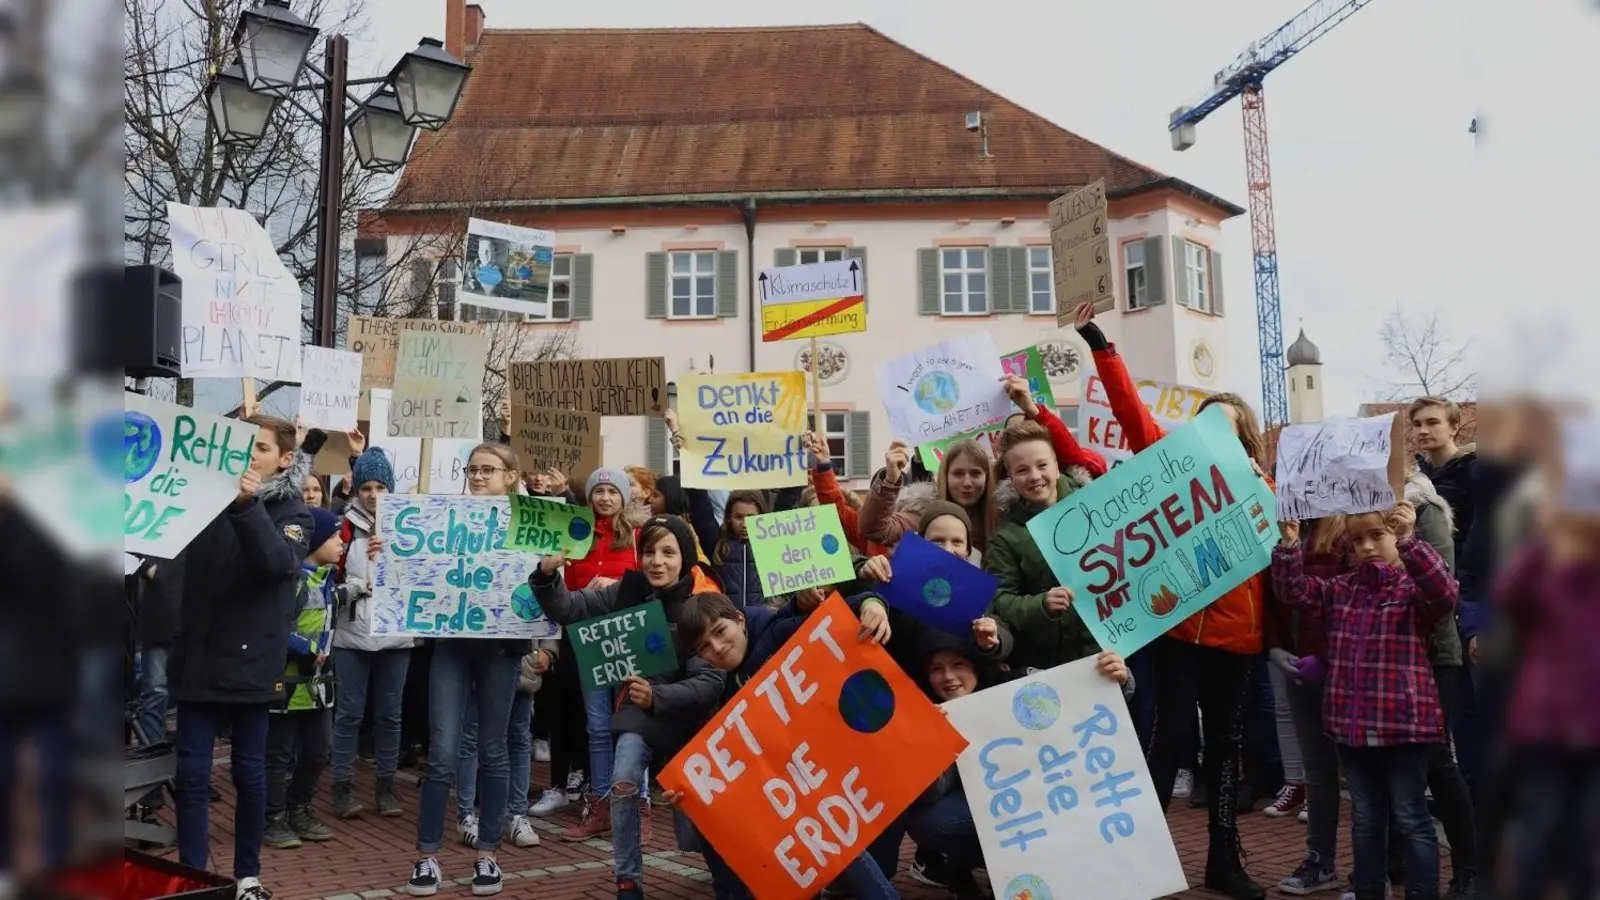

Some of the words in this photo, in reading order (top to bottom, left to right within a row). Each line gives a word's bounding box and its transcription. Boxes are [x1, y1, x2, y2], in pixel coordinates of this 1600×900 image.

[1093, 216, 1101, 236] 6
[190, 239, 282, 279] GIRL
[1094, 246, 1103, 264] 6
[215, 278, 274, 302] NT
[769, 272, 849, 296] Klimaschutz
[1097, 275, 1105, 293] 6
[357, 317, 398, 335] THERE
[183, 325, 290, 377] PLANET
[353, 340, 376, 353] ON
[402, 335, 453, 360] KLIMA
[398, 360, 468, 380] SCHUTZ
[512, 362, 544, 391] BIENE
[550, 361, 585, 389] MAYA
[592, 360, 624, 388] SOLL
[627, 359, 661, 389] KEIN
[698, 380, 780, 409] Denkt
[1086, 375, 1110, 408] E
[389, 419, 471, 437] SCHMUTZ
[525, 410, 549, 427] DAS
[555, 412, 590, 434] KLIMA
[713, 409, 740, 426] an
[745, 407, 774, 425] die
[171, 414, 255, 476] Rettet
[697, 434, 807, 477] Zukunft
[150, 466, 188, 496] die
[519, 508, 546, 528] DIE
[1053, 474, 1154, 556] Change
[1157, 449, 1196, 484] the
[514, 526, 563, 552] ERDE
[1078, 463, 1236, 595] SYSTEM
[781, 544, 811, 566] den
[1103, 616, 1137, 644] the
[1137, 493, 1273, 620] CLIMATE
[445, 557, 494, 591] die
[768, 564, 836, 593] Planeten
[406, 590, 486, 632] Erde
[1095, 582, 1131, 623] NOT
[578, 609, 647, 645] RETTET
[601, 633, 632, 658] DIE
[592, 655, 643, 687] ERDE
[682, 615, 846, 806] RETTET
[762, 741, 829, 820] DIE
[1038, 744, 1079, 815] die
[1071, 703, 1142, 844] Rette
[978, 736, 1048, 853] Welt
[774, 765, 885, 889] ERDE
